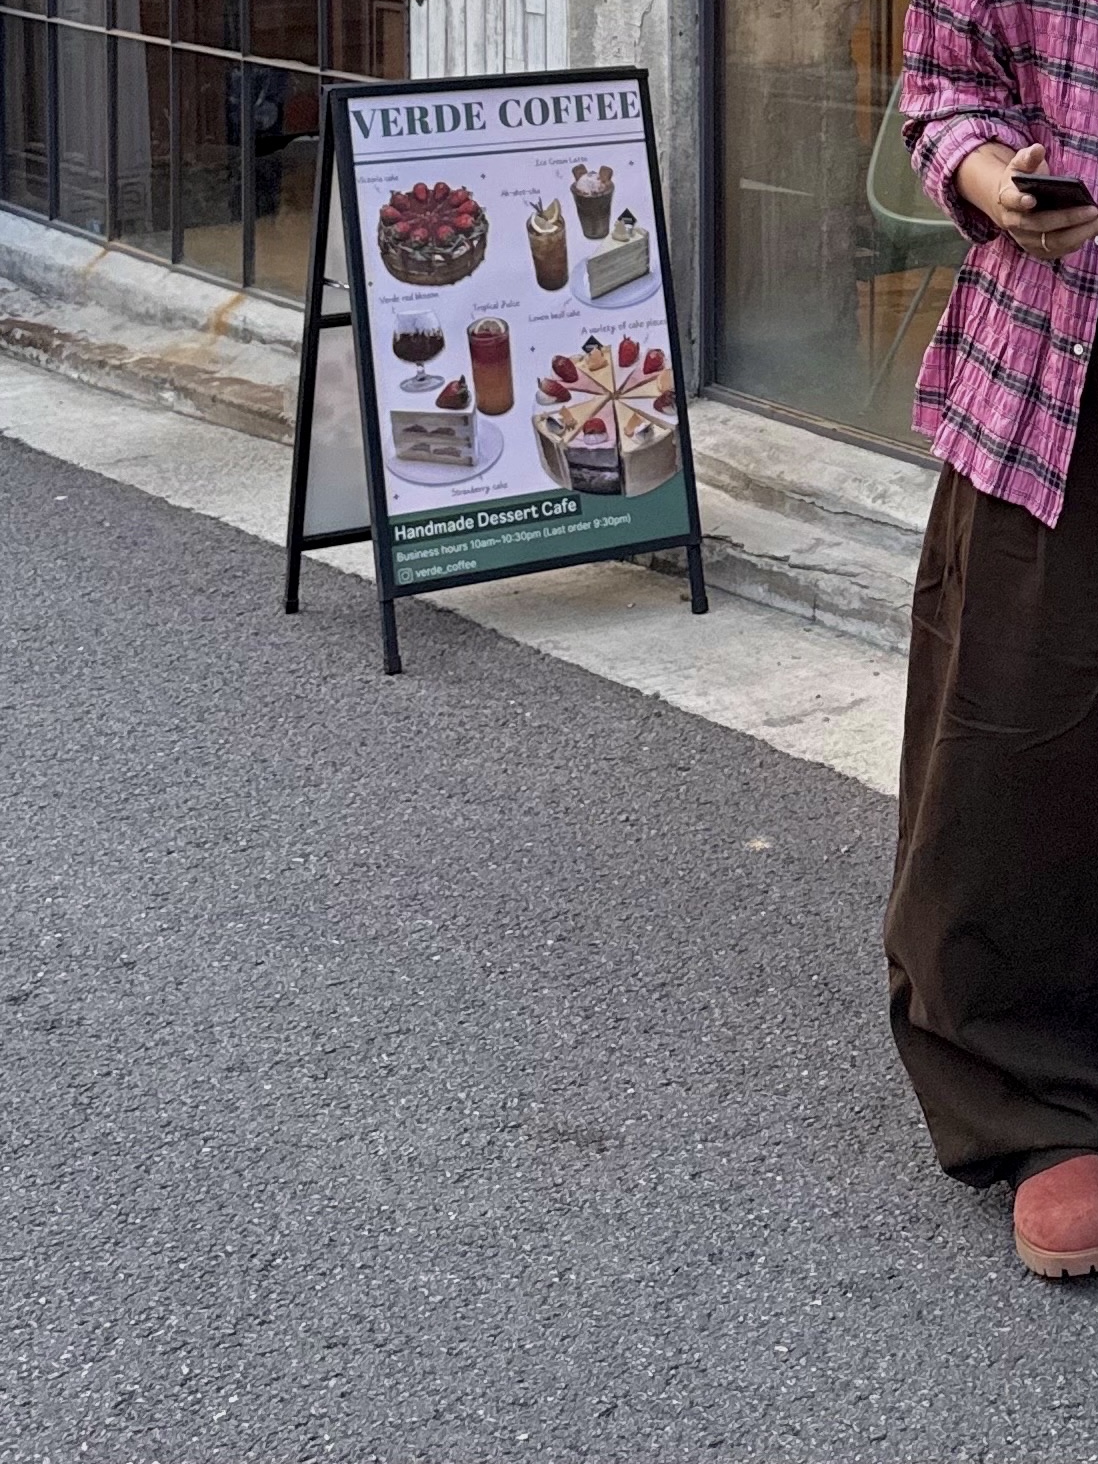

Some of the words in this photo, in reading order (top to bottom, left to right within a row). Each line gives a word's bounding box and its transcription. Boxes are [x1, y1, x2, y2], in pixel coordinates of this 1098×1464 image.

[351, 101, 487, 139] VERDE
[498, 90, 641, 129] COFFEE
[581, 326, 588, 335] A
[589, 323, 616, 335] variety
[618, 320, 627, 331] of
[628, 319, 645, 329] cake
[394, 516, 475, 541] Handmade
[477, 505, 539, 528] Dessert
[541, 497, 578, 517] Cafe
[396, 545, 440, 563] Business
[441, 540, 468, 555] hours
[543, 525, 567, 540] (Last
[567, 521, 592, 534] order
[593, 513, 632, 530] 9:30pm)
[415, 558, 477, 578] verde_coffee
